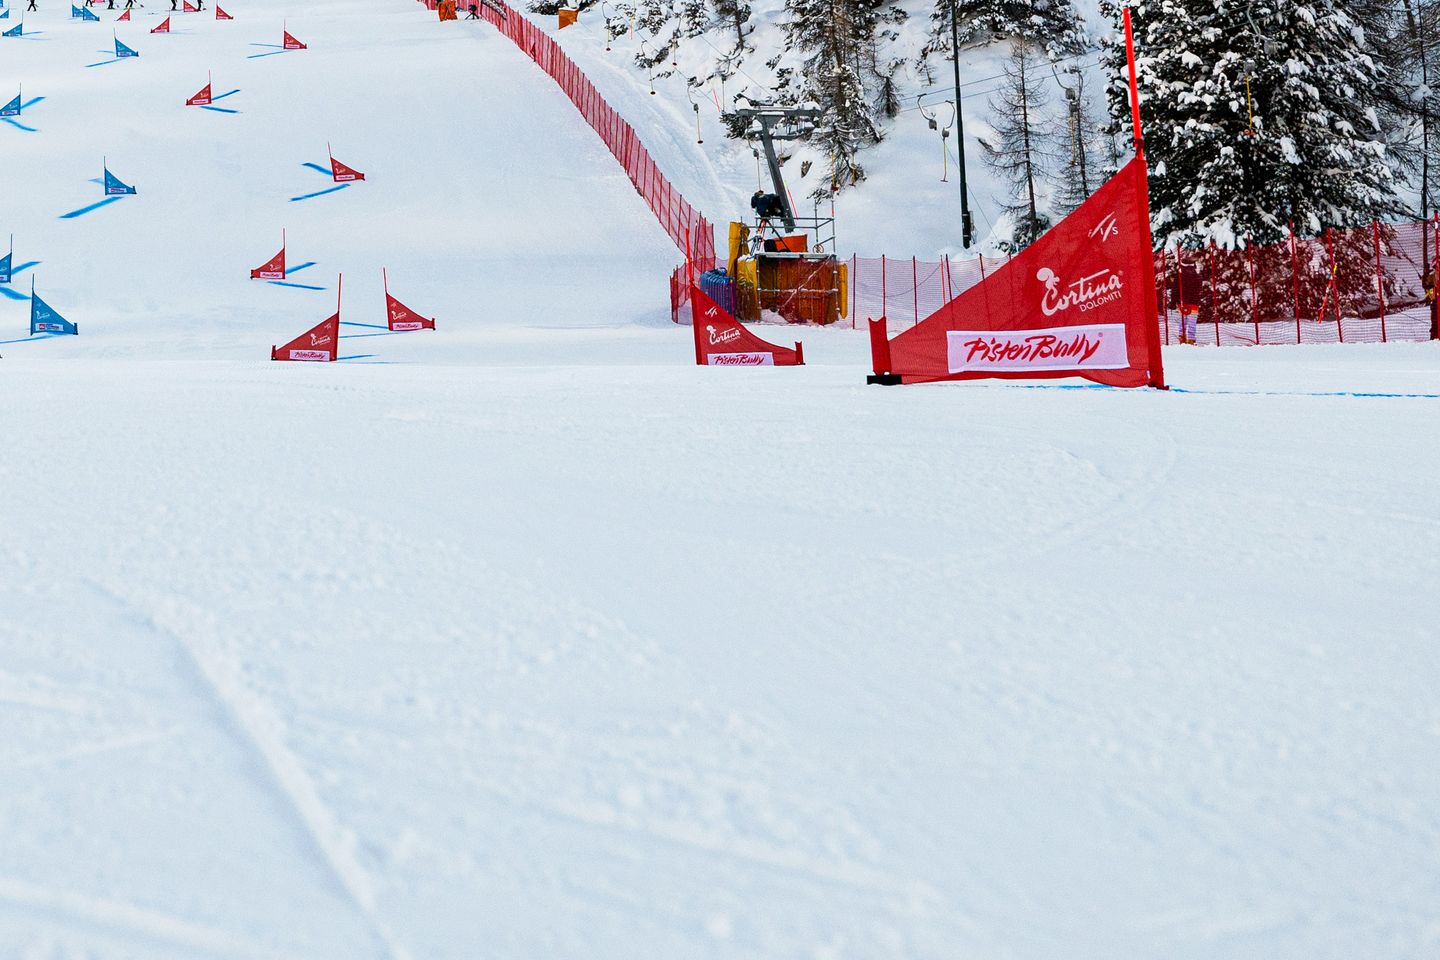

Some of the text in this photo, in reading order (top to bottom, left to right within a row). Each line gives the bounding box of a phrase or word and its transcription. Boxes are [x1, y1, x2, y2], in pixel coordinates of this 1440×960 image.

[1041, 268, 1124, 316] Cortina
[1079, 290, 1122, 312] DOLOMITI
[709, 327, 741, 345] Cortina
[963, 333, 1100, 365] PistenBully
